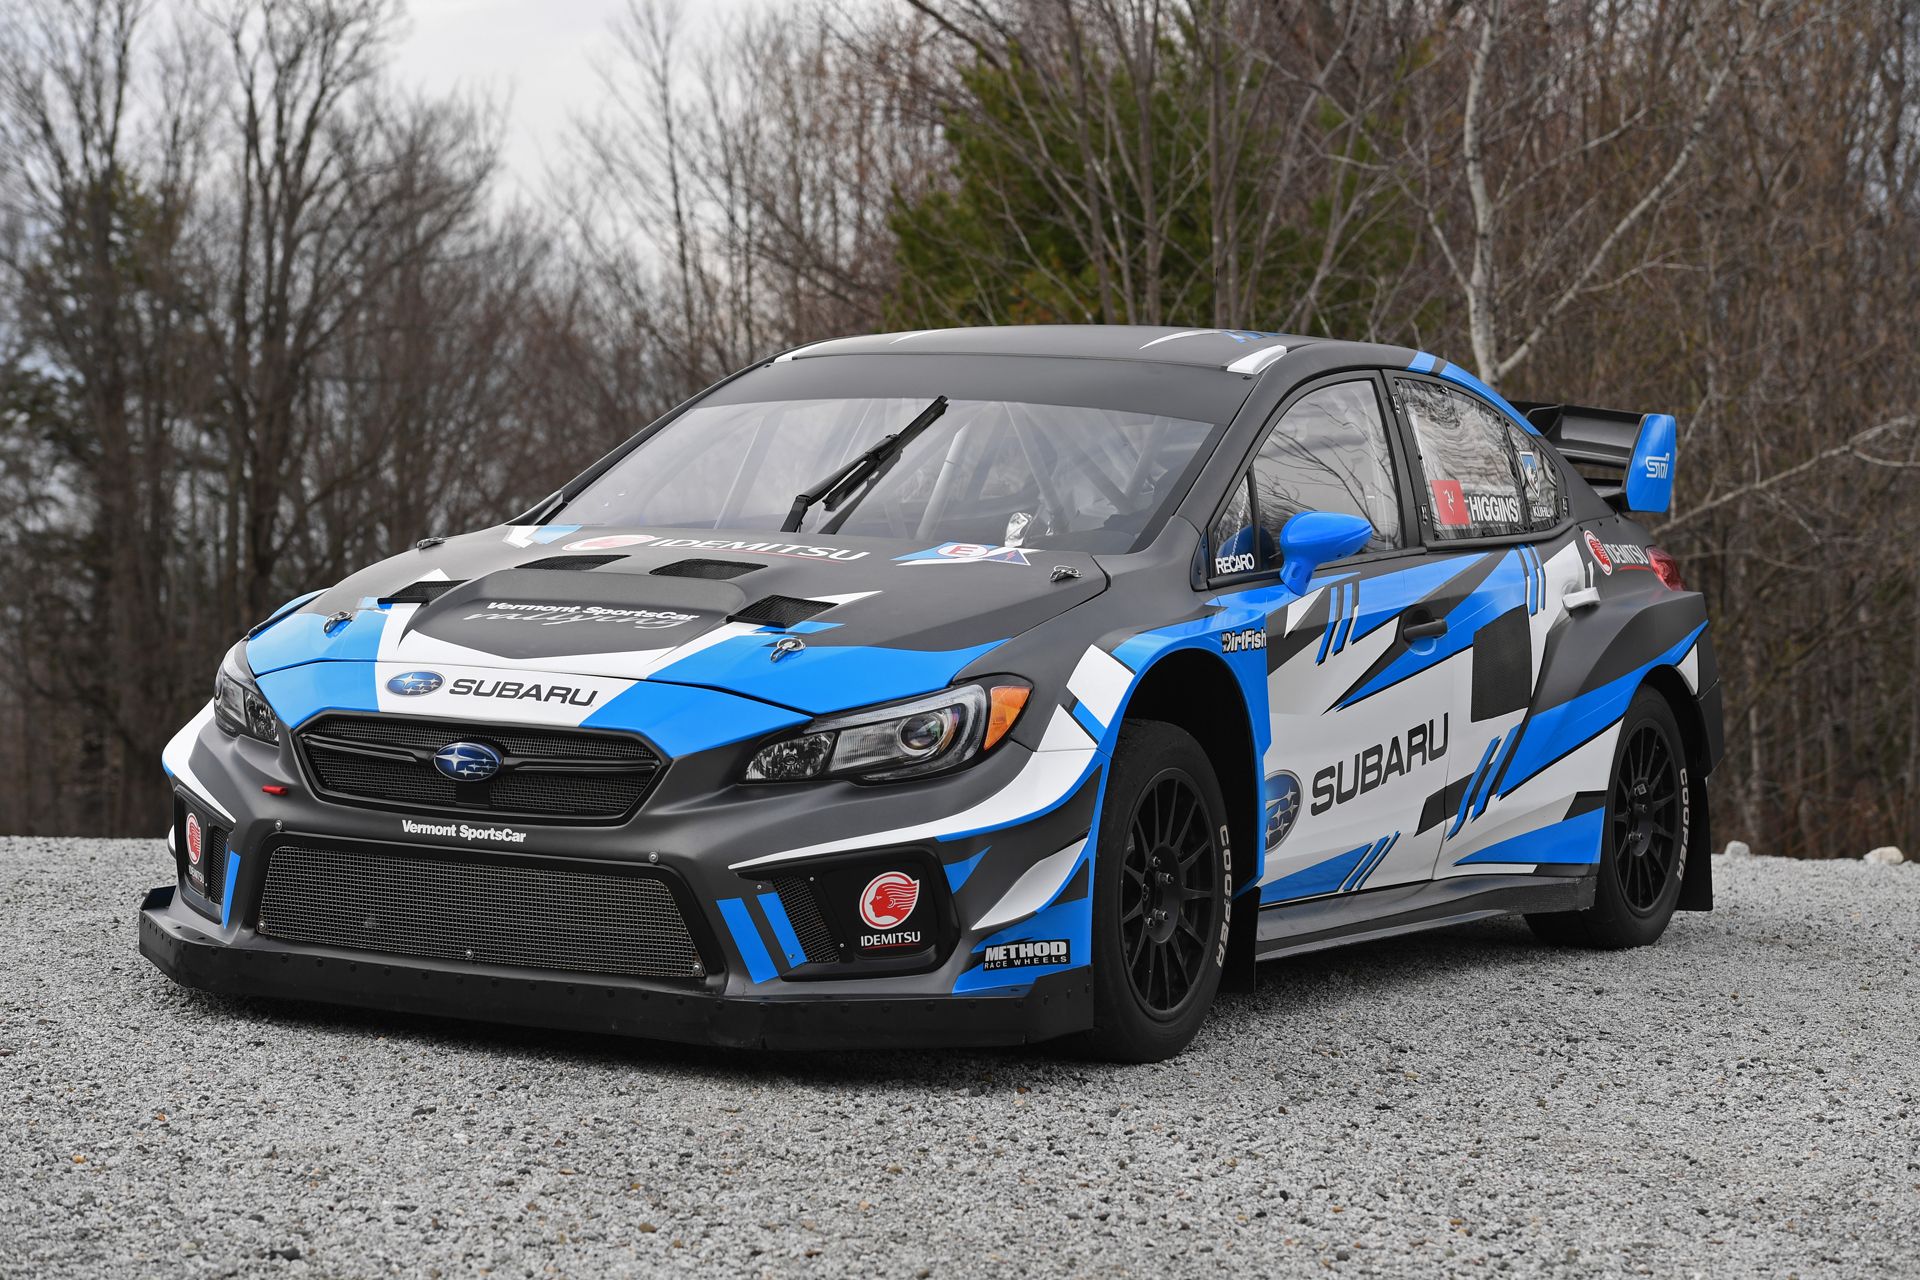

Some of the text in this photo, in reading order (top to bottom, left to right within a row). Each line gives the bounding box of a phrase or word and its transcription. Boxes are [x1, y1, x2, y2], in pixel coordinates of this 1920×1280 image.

[1468, 494, 1519, 522] HIGGINS
[648, 536, 870, 561] IDEMITSU
[1603, 543, 1649, 564] IDEMITSU
[1215, 553, 1255, 574] RECARO
[487, 602, 700, 620] Vermont SportsCar
[1222, 628, 1267, 652] DirtFish
[449, 678, 598, 707] SUBARU
[1311, 712, 1448, 816] SUBARU
[402, 820, 527, 843] Vermont SportsCar
[1676, 767, 1690, 881] COOPER
[1215, 824, 1233, 968] COOPER
[861, 931, 920, 947] IDEMITSU
[984, 955, 1067, 970] RACE WHEELS
[985, 941, 1067, 962] METHOD
